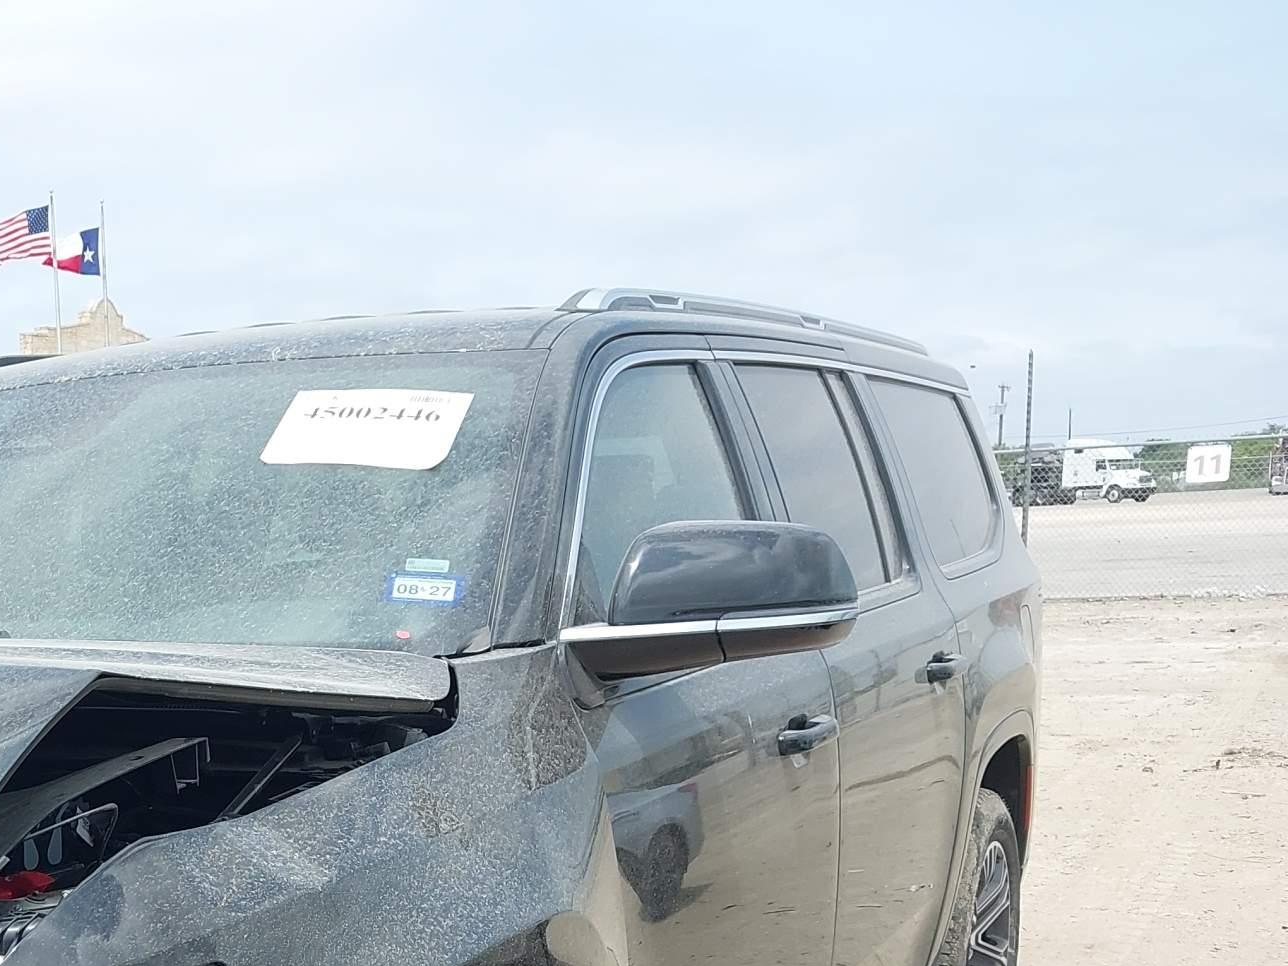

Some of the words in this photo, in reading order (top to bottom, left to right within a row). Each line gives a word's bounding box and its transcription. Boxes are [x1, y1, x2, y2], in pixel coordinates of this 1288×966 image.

[303, 406, 440, 422] 45002446
[1193, 453, 1223, 476] 11
[396, 583, 419, 595] 08
[429, 585, 452, 597] 27
